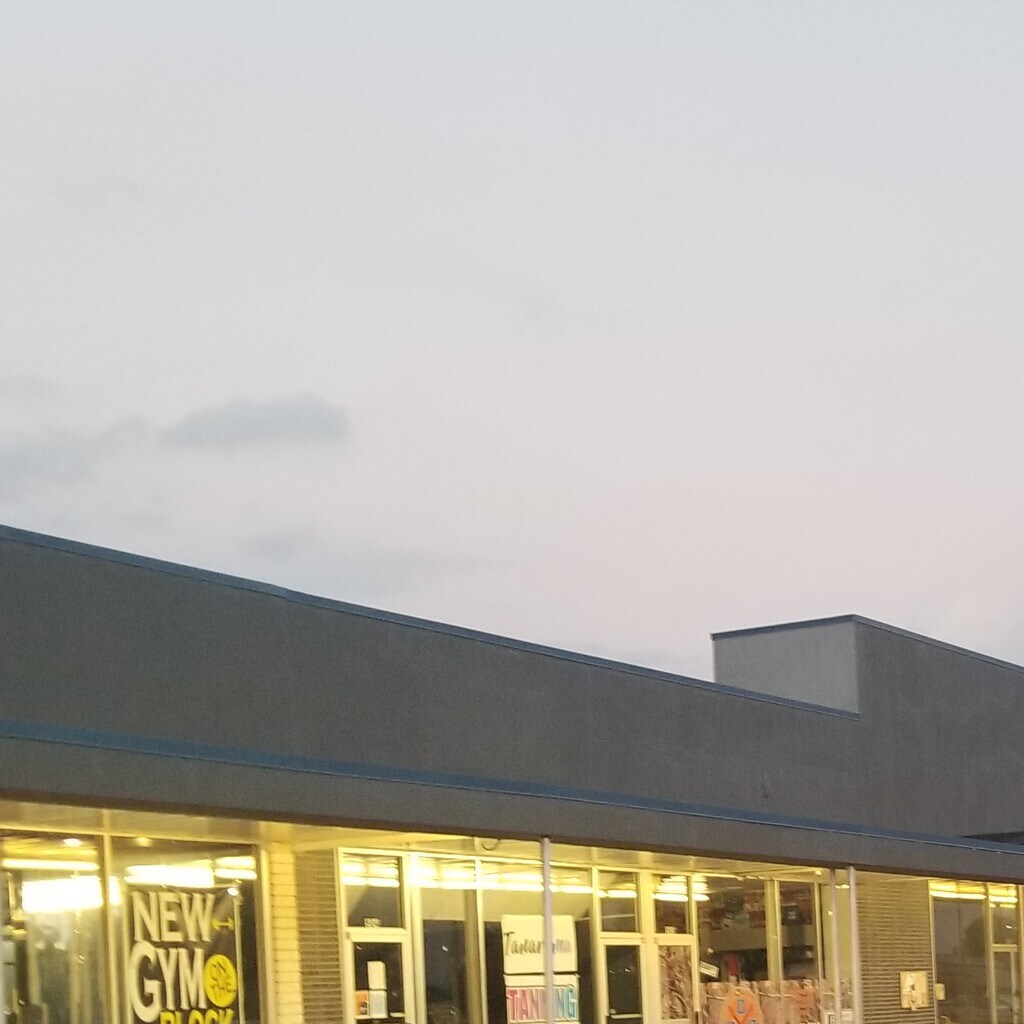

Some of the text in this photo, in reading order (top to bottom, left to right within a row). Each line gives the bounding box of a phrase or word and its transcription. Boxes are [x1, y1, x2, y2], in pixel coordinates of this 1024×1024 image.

[131, 891, 215, 942] NEW
[129, 940, 207, 1023] GYM
[507, 986, 578, 1021] TANNNG
